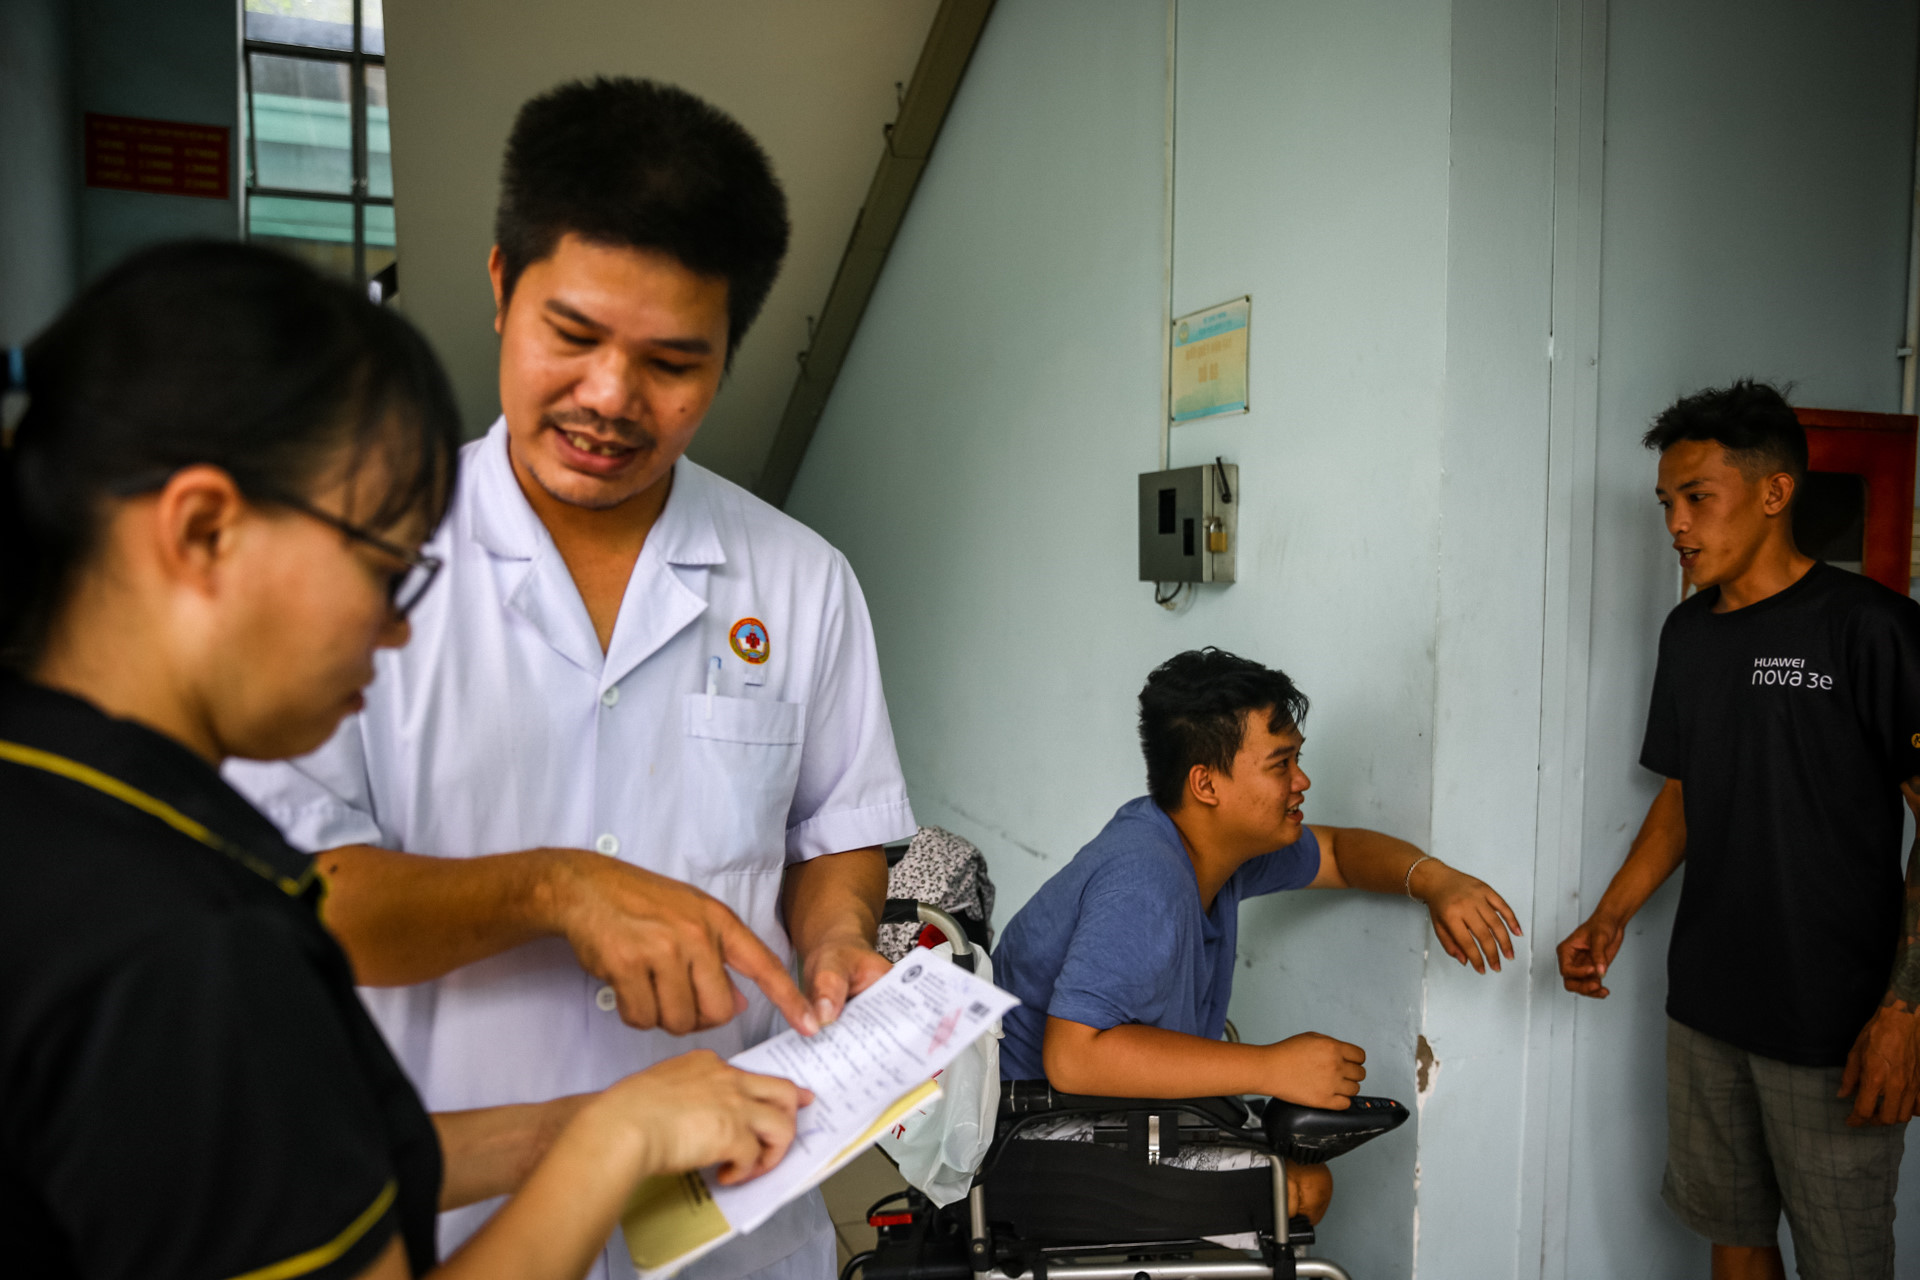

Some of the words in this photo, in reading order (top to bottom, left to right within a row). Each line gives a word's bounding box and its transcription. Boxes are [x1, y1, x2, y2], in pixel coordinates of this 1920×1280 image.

[1754, 657, 1805, 668] HUAWEI
[1752, 669, 1802, 686] nova
[1806, 672, 1833, 690] 3e
